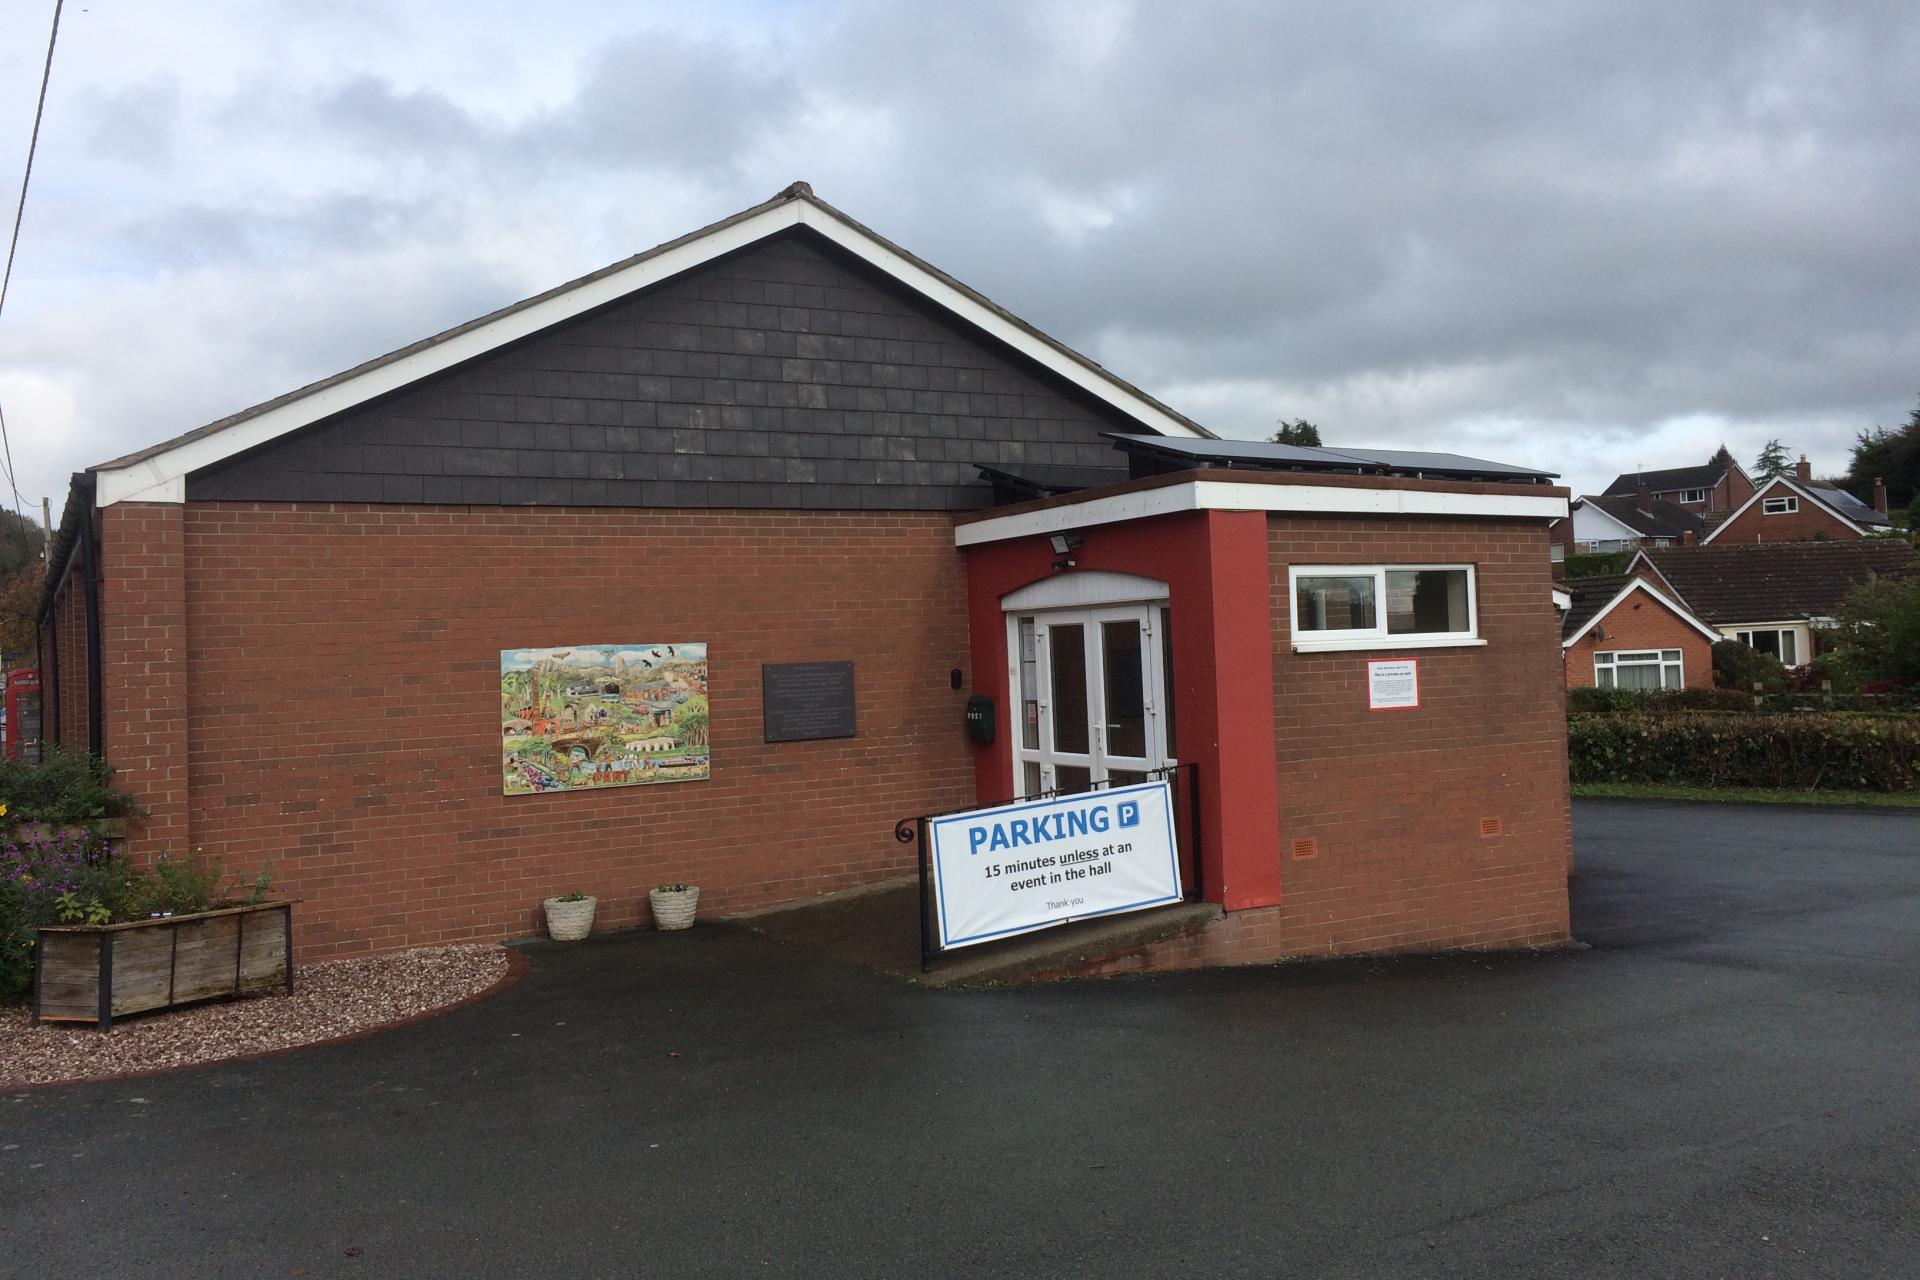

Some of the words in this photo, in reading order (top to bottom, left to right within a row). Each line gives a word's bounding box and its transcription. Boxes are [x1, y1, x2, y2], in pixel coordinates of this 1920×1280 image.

[968, 712, 982, 720] POST
[969, 805, 1110, 855] PARKING
[1121, 806, 1134, 824] P
[985, 864, 1001, 878] 15
[1005, 855, 1056, 874] minutes
[1060, 848, 1099, 866] unless
[1102, 845, 1115, 856] at
[1118, 843, 1133, 853] an
[1010, 876, 1047, 891] event
[1050, 872, 1061, 884] in
[1065, 868, 1086, 881] the
[1089, 861, 1111, 876] hall
[1046, 898, 1068, 910] Thank
[1070, 897, 1084, 908] you
